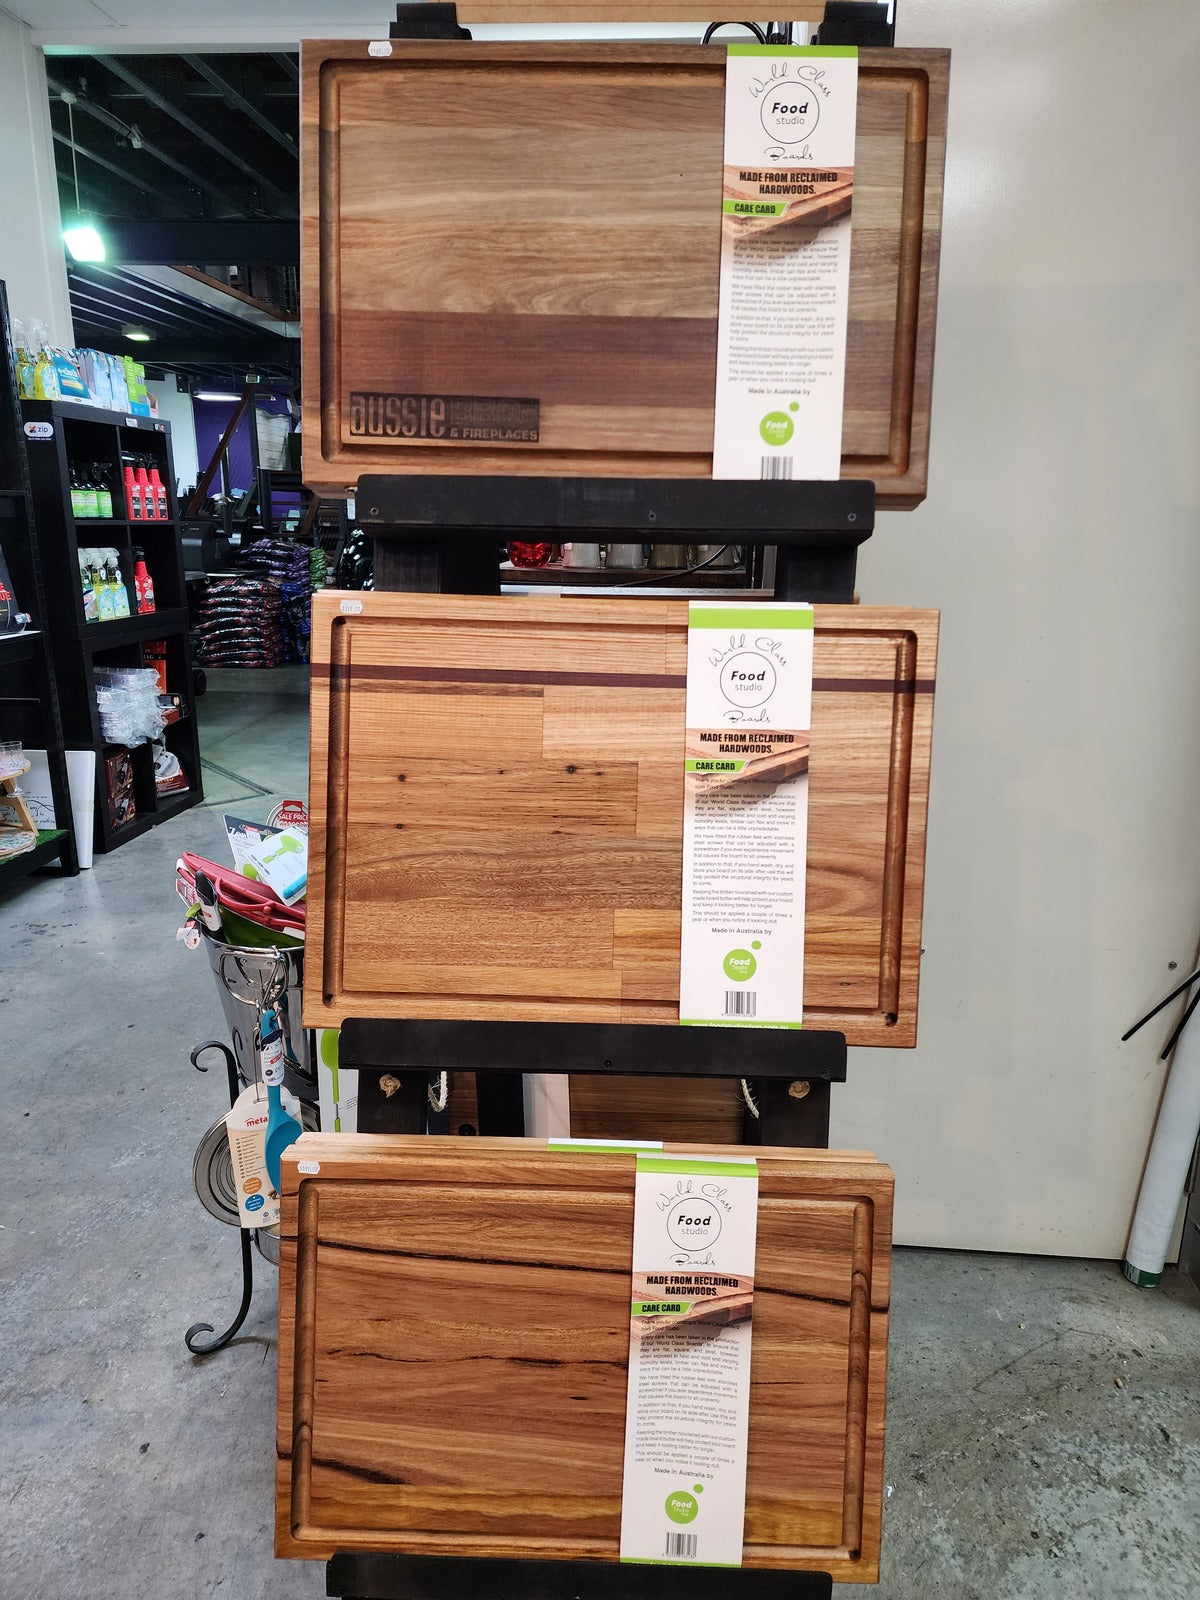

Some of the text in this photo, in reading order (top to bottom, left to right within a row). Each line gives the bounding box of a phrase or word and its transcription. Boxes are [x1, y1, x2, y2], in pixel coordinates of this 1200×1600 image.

[749, 62, 831, 98] World Class
[772, 102, 808, 114] Food
[776, 116, 805, 125] studio
[764, 145, 814, 161] Boards
[739, 172, 838, 183] MADE FROM RECLAIMED
[759, 184, 816, 195] HARDWOODS.
[735, 203, 776, 214] CARE CARD
[350, 395, 445, 437] aussie
[765, 420, 788, 429] Food
[450, 428, 538, 440] & FIREPLACES
[708, 634, 787, 667] World Class
[731, 671, 766, 681] Food
[723, 709, 771, 723] Boards
[700, 733, 794, 743] MADE FROM RECLAIMED
[719, 744, 774, 753] HARDWOODS.
[696, 762, 735, 770] CARE CARD
[246, 1117, 268, 1127] meta
[656, 1180, 732, 1212] World Class
[678, 1215, 711, 1226] Food
[670, 1252, 716, 1266] Boards
[647, 1276, 739, 1288] MADE FROM RECLAIMED
[665, 1286, 718, 1296] HARDWOODS.
[642, 1304, 681, 1312] CARE CARD
[671, 1500, 692, 1508] Food
